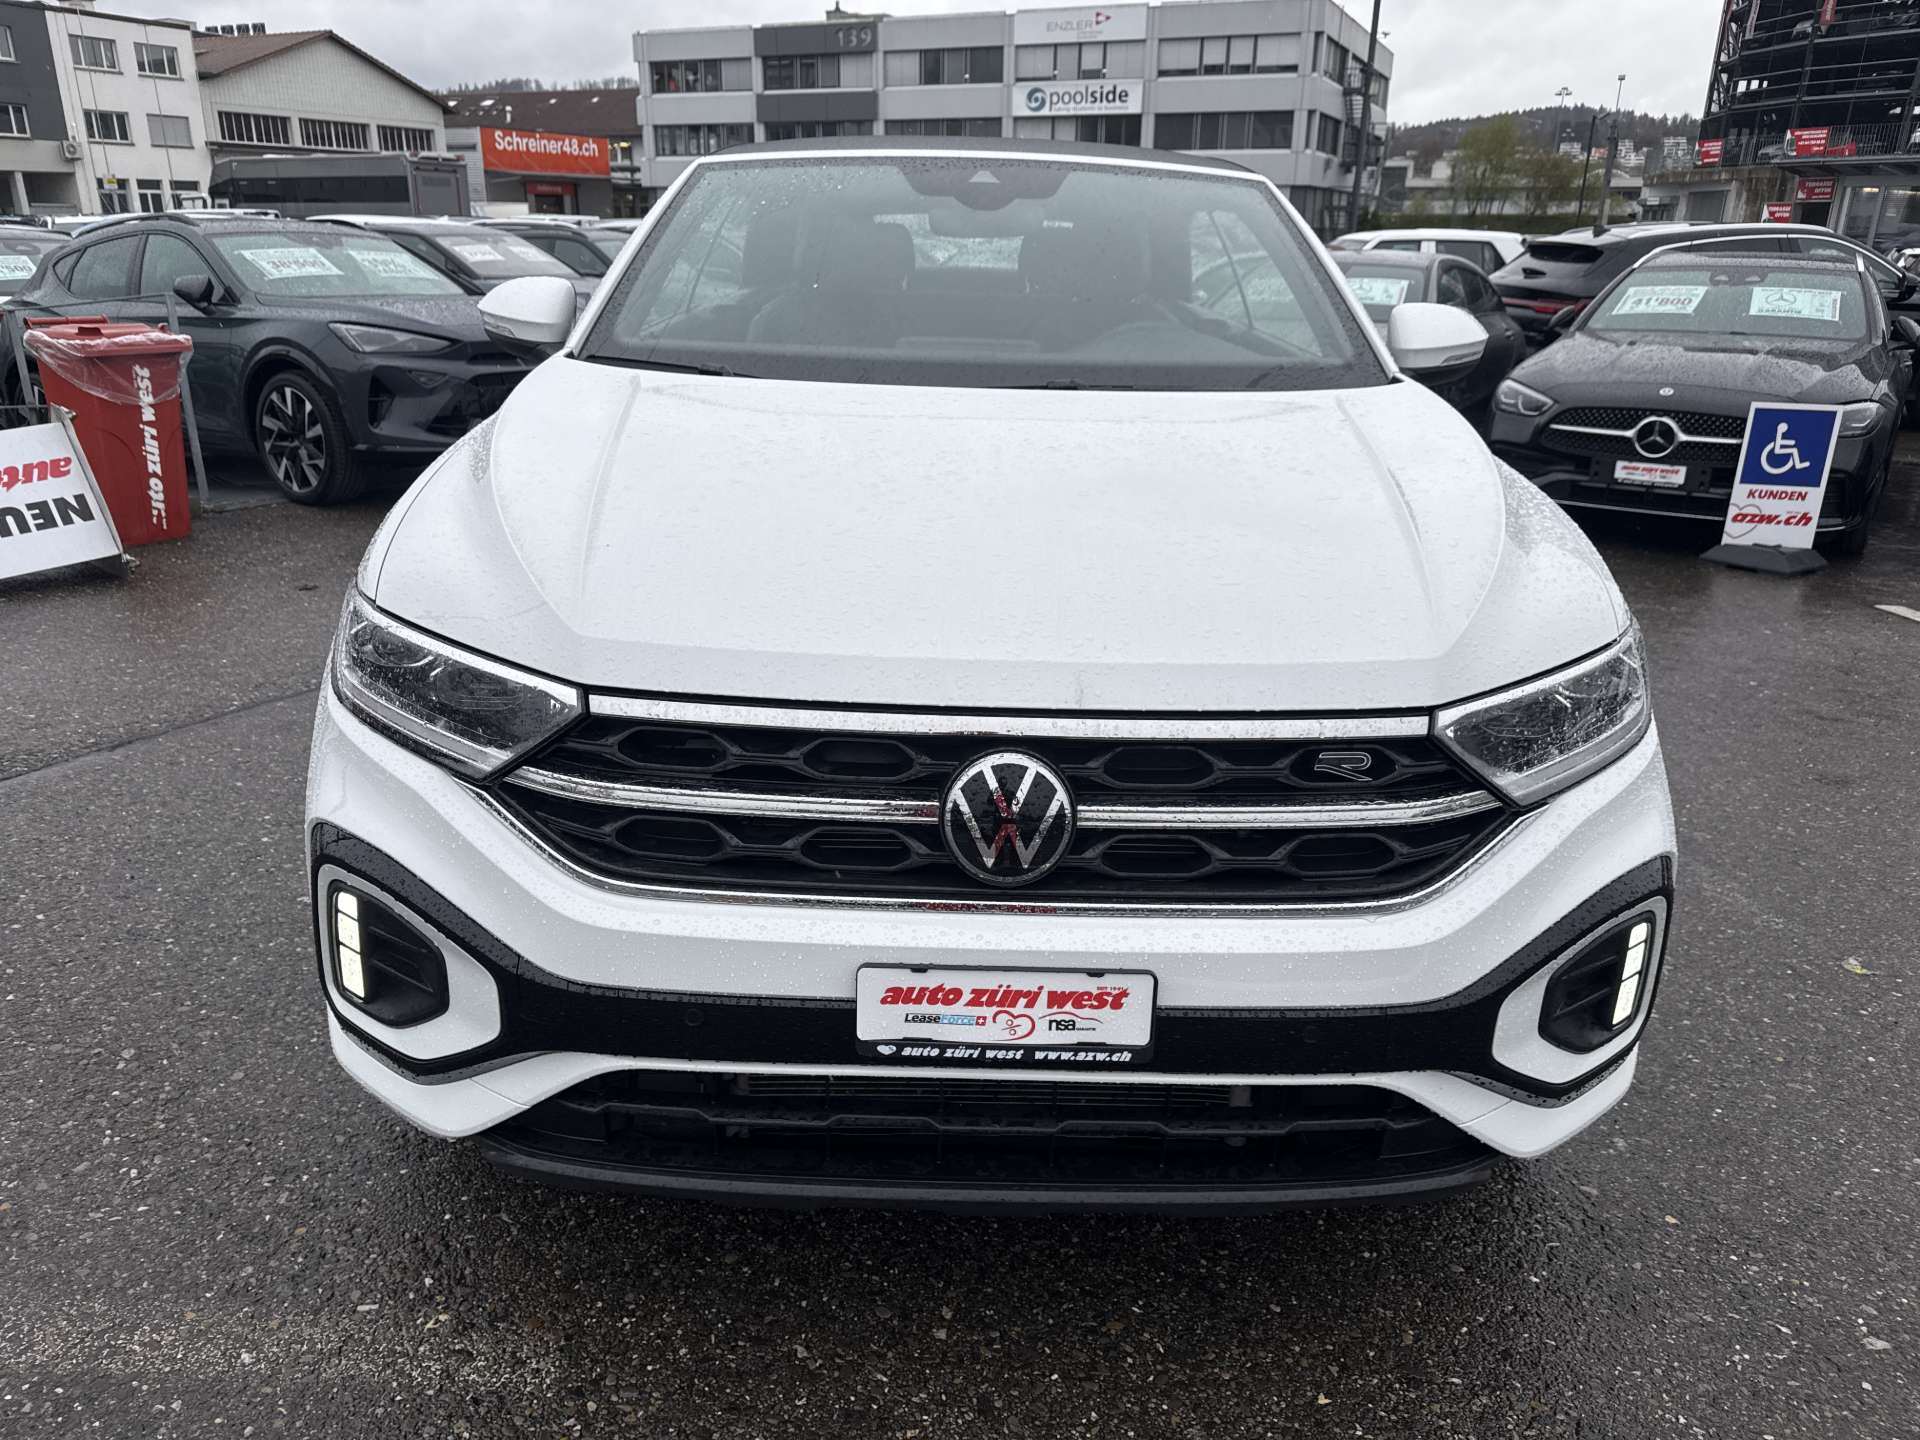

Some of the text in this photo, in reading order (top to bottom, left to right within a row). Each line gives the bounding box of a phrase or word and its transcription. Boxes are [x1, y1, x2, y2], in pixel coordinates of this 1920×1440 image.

[1046, 20, 1093, 32] ENZLER
[838, 29, 872, 47] 139
[1049, 84, 1129, 112] poolside
[494, 130, 599, 157] Schreiner48.ch
[134, 363, 157, 422] west
[139, 424, 163, 477] züri
[0, 456, 72, 492] aut
[1747, 488, 1808, 501] KUNDEN
[1731, 512, 1813, 527] azw.ch
[880, 983, 1130, 1010] auto züri west
[904, 1013, 976, 1025] LeaseForce
[1049, 1019, 1076, 1031] nsa
[901, 1046, 1132, 1062] auto züri west www.azw.ch
